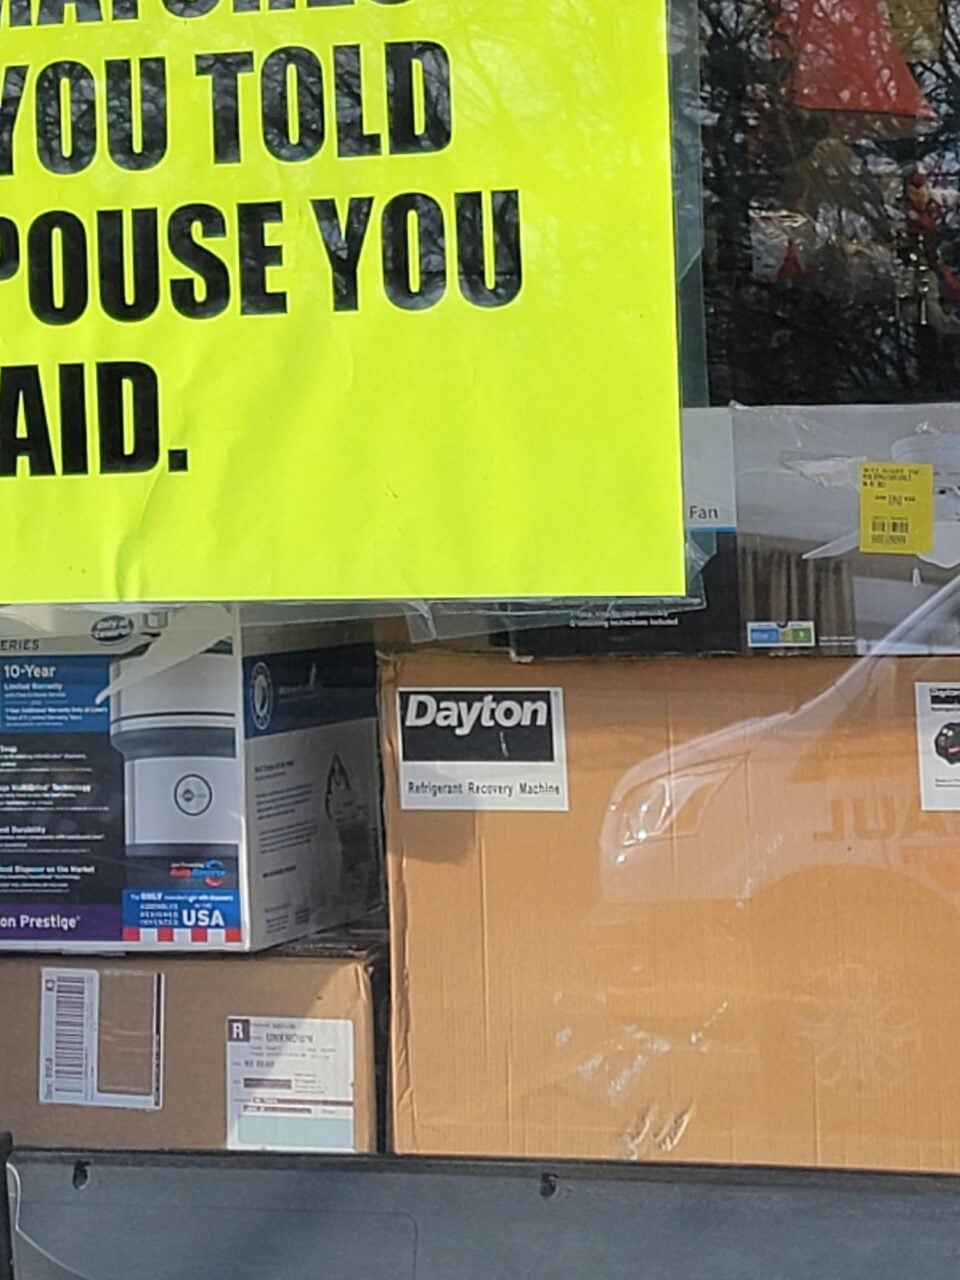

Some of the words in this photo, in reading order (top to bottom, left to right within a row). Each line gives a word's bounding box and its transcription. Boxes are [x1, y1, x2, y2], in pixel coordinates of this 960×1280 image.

[196, 41, 453, 164] TOLD
[313, 191, 523, 311] YOU
[689, 505, 718, 520] Fan
[3, 664, 56, 679] 10-Year
[405, 694, 548, 736] Dayton
[408, 781, 463, 797] Refrigerant
[468, 781, 514, 797] Recovery
[519, 782, 560, 795] Machine
[20, 914, 77, 931] Prestige
[182, 909, 225, 927] USA
[231, 1022, 244, 1039] R
